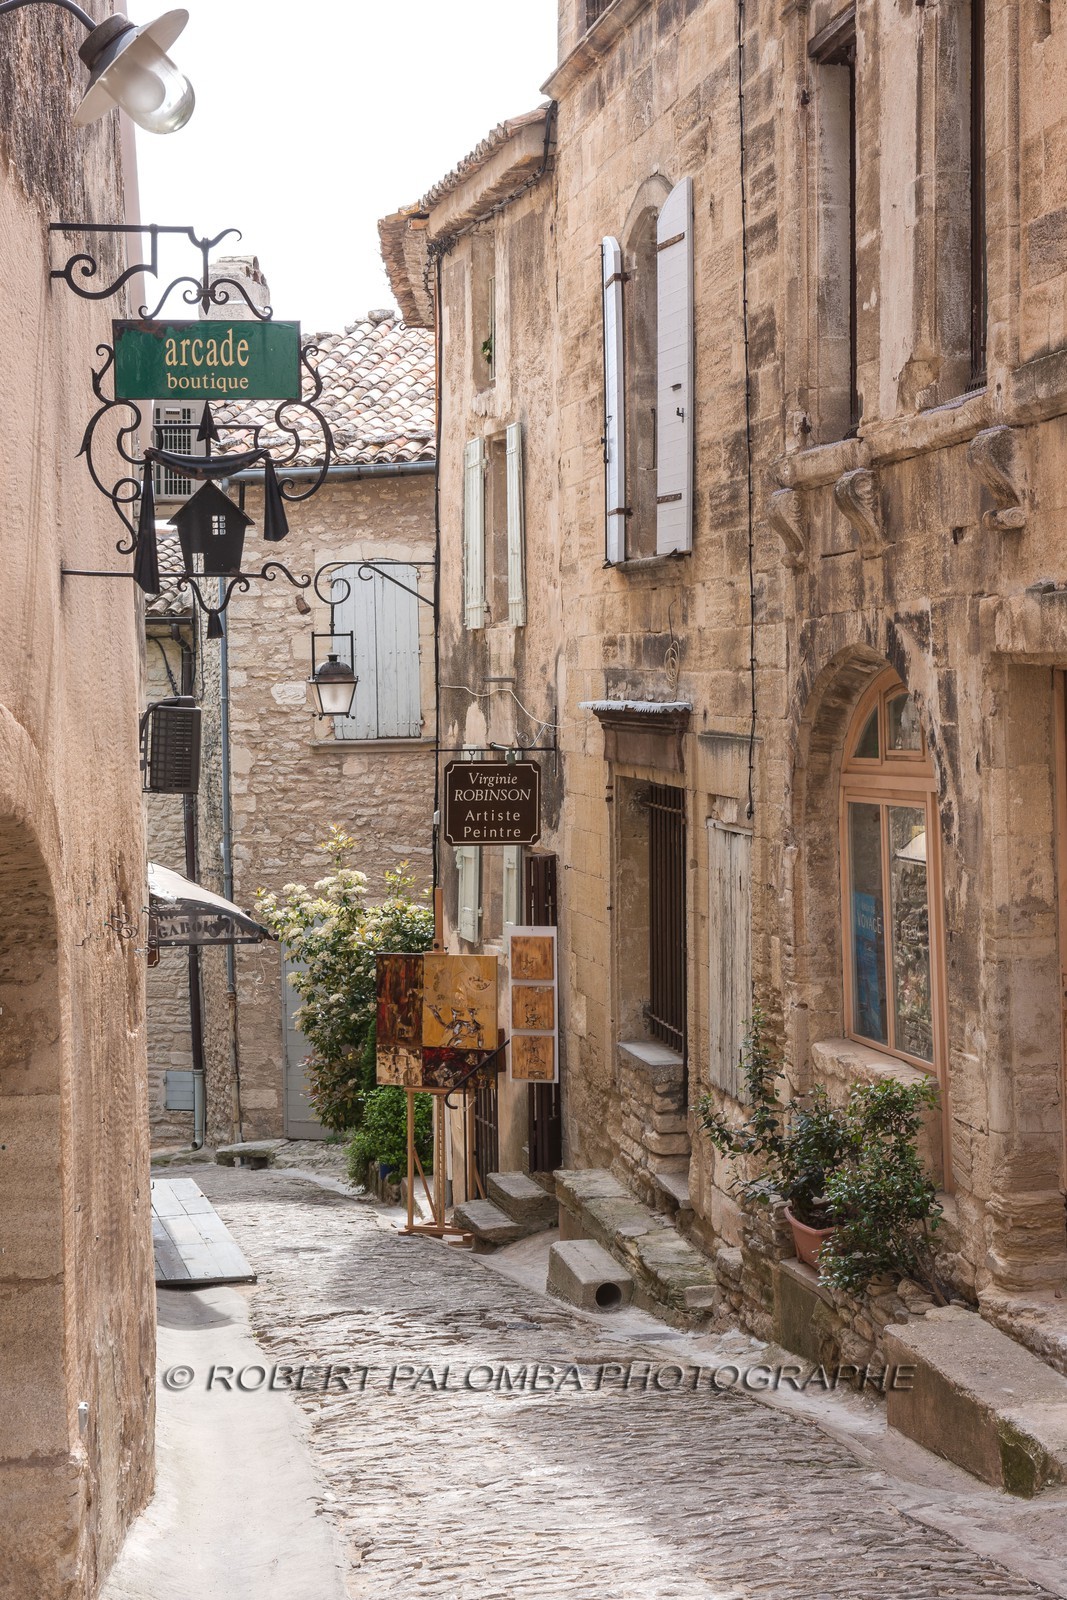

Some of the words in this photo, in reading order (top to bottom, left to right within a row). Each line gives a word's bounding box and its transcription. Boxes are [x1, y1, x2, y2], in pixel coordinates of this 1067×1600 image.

[165, 328, 249, 367] arcade
[166, 372, 249, 393] boutique
[468, 772, 518, 788] Virginie
[454, 788, 531, 802] ROBINSON
[464, 809, 521, 822] Artiste
[463, 826, 521, 838] Peintre
